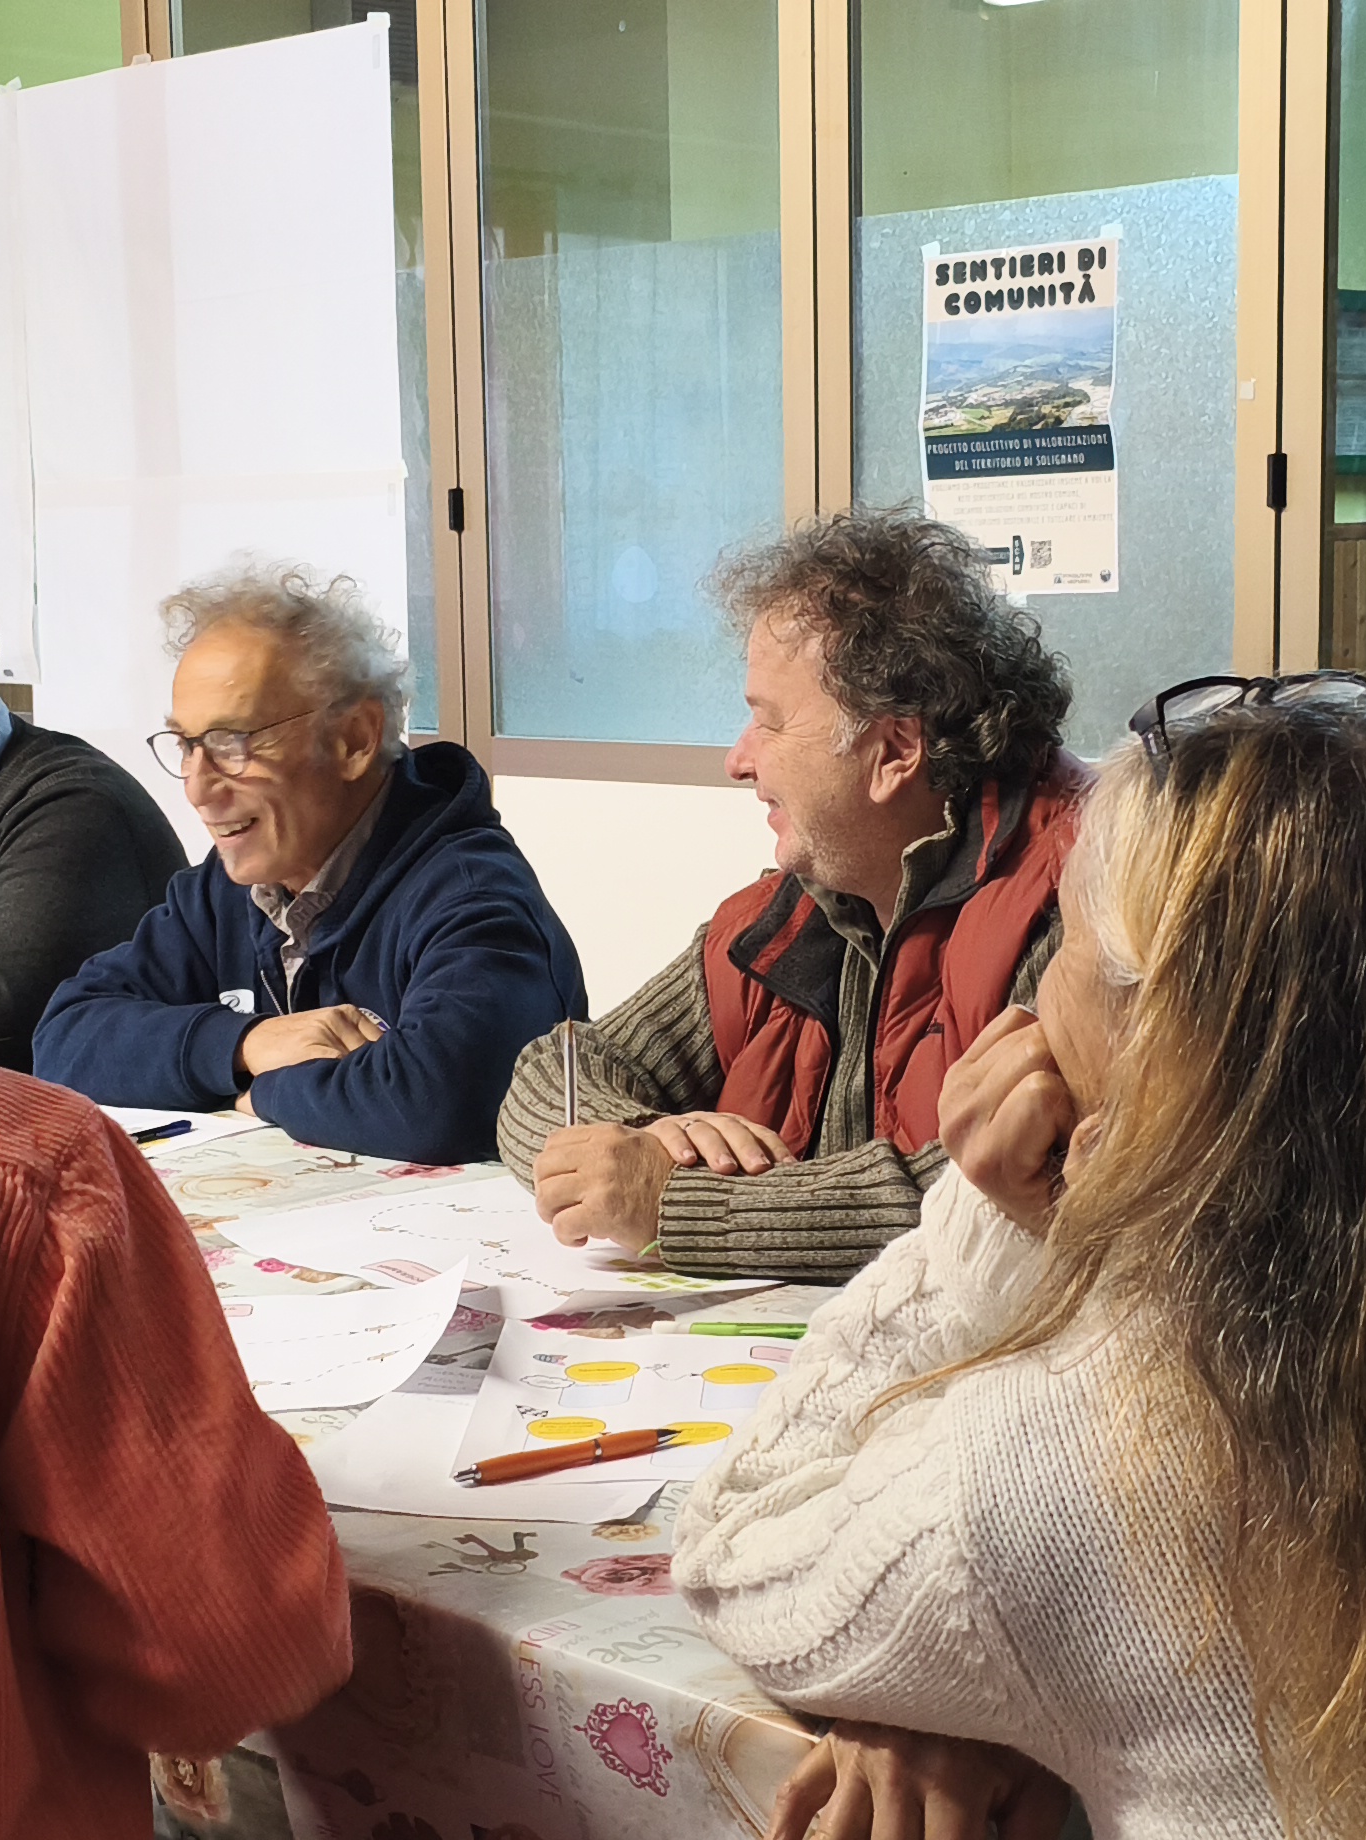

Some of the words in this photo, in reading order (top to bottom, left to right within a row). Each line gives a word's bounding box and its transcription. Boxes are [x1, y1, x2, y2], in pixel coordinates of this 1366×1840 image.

[935, 251, 1065, 286] SENTIERI
[1077, 246, 1107, 272] DI
[944, 273, 1096, 316] COMUNITÀ
[927, 442, 968, 455] PROGETTO
[970, 439, 1021, 453] COLLETTIVO
[1023, 438, 1032, 449] DI
[1035, 433, 1108, 448] VALORIZZAZIONE
[954, 460, 969, 471] DEL
[972, 456, 1021, 470] TERRITORIO
[1024, 456, 1033, 467] DI
[1036, 453, 1085, 466] SOLIGNANO
[518, 1620, 582, 1711] ENDLESS
[527, 1723, 563, 1807] LOVE
